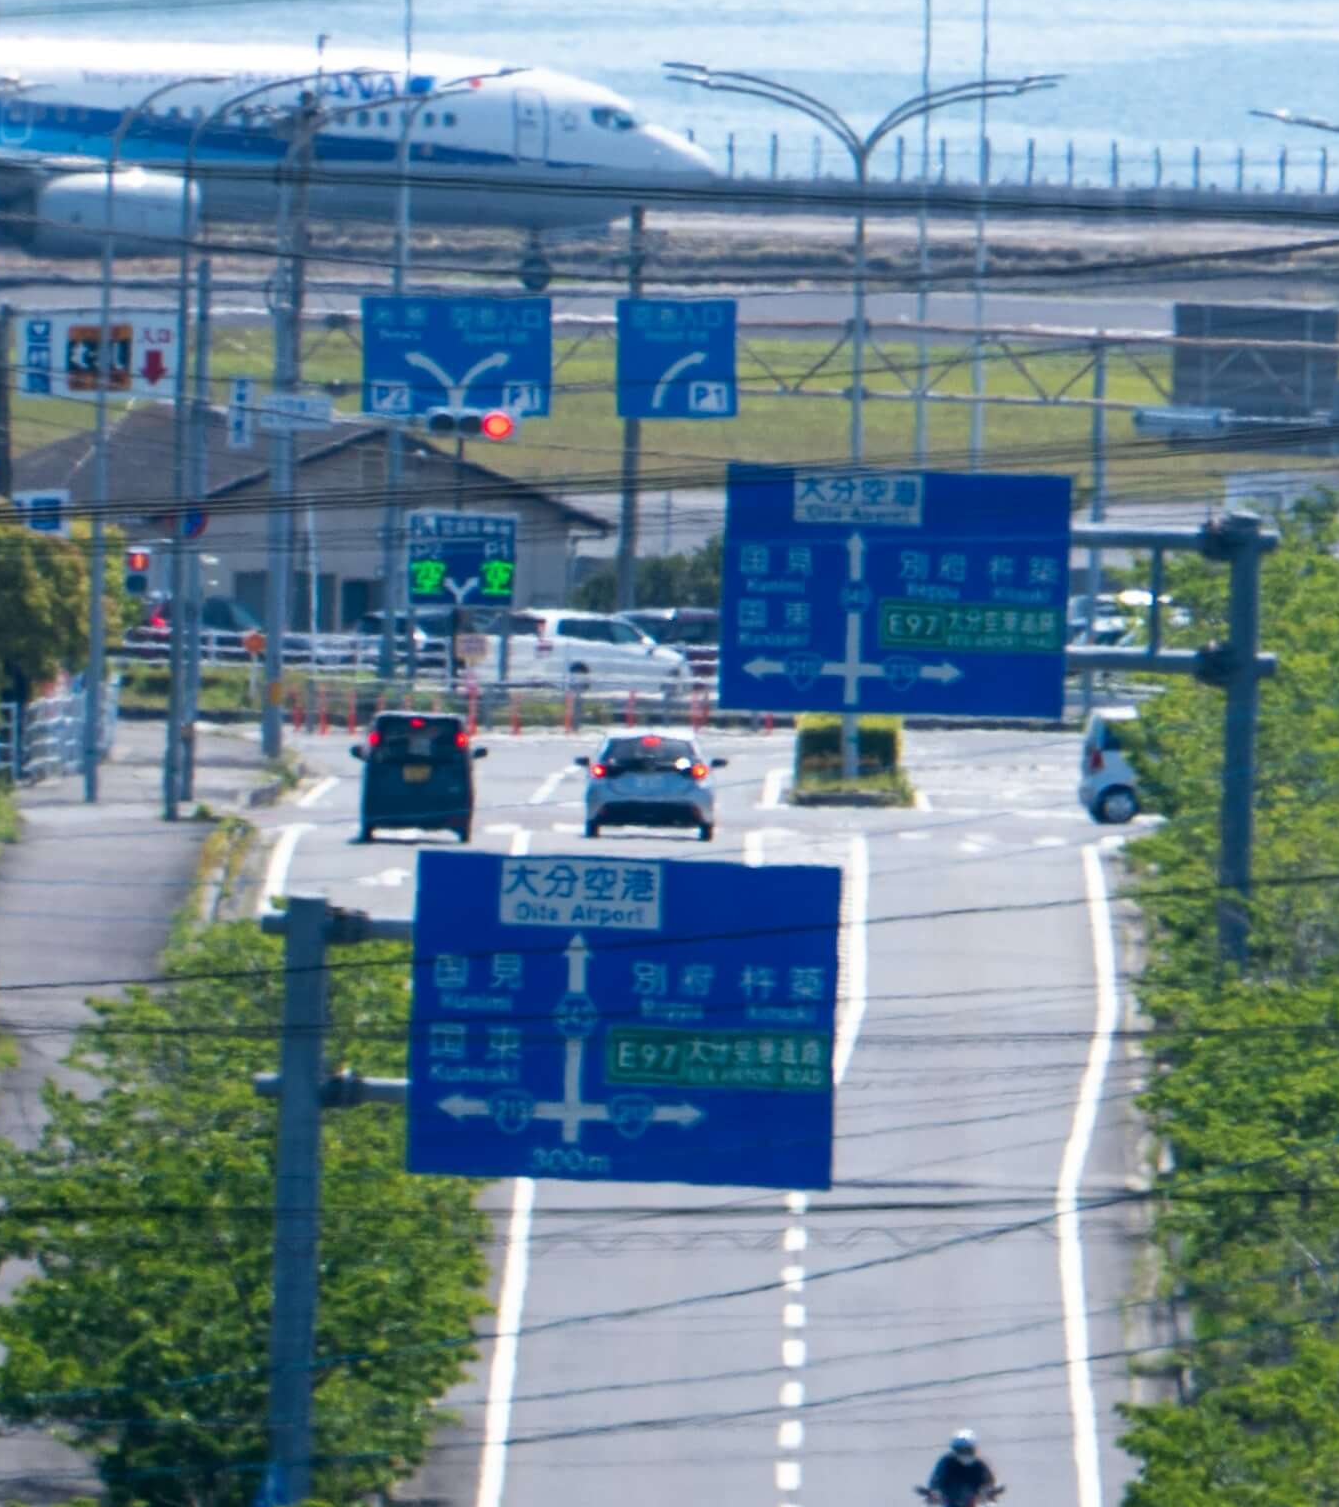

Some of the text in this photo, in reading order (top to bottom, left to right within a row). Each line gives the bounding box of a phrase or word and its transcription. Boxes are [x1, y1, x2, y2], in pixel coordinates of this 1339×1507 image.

[888, 612, 939, 637] E97
[505, 863, 655, 903] 大分空港
[516, 903, 643, 926] Oita Airport
[434, 953, 524, 989] 国見
[632, 960, 715, 997] 別府
[739, 964, 824, 1001] 杵築
[429, 1022, 522, 1060] 国東
[618, 1040, 678, 1070] E97
[531, 1147, 612, 1173] 300m
